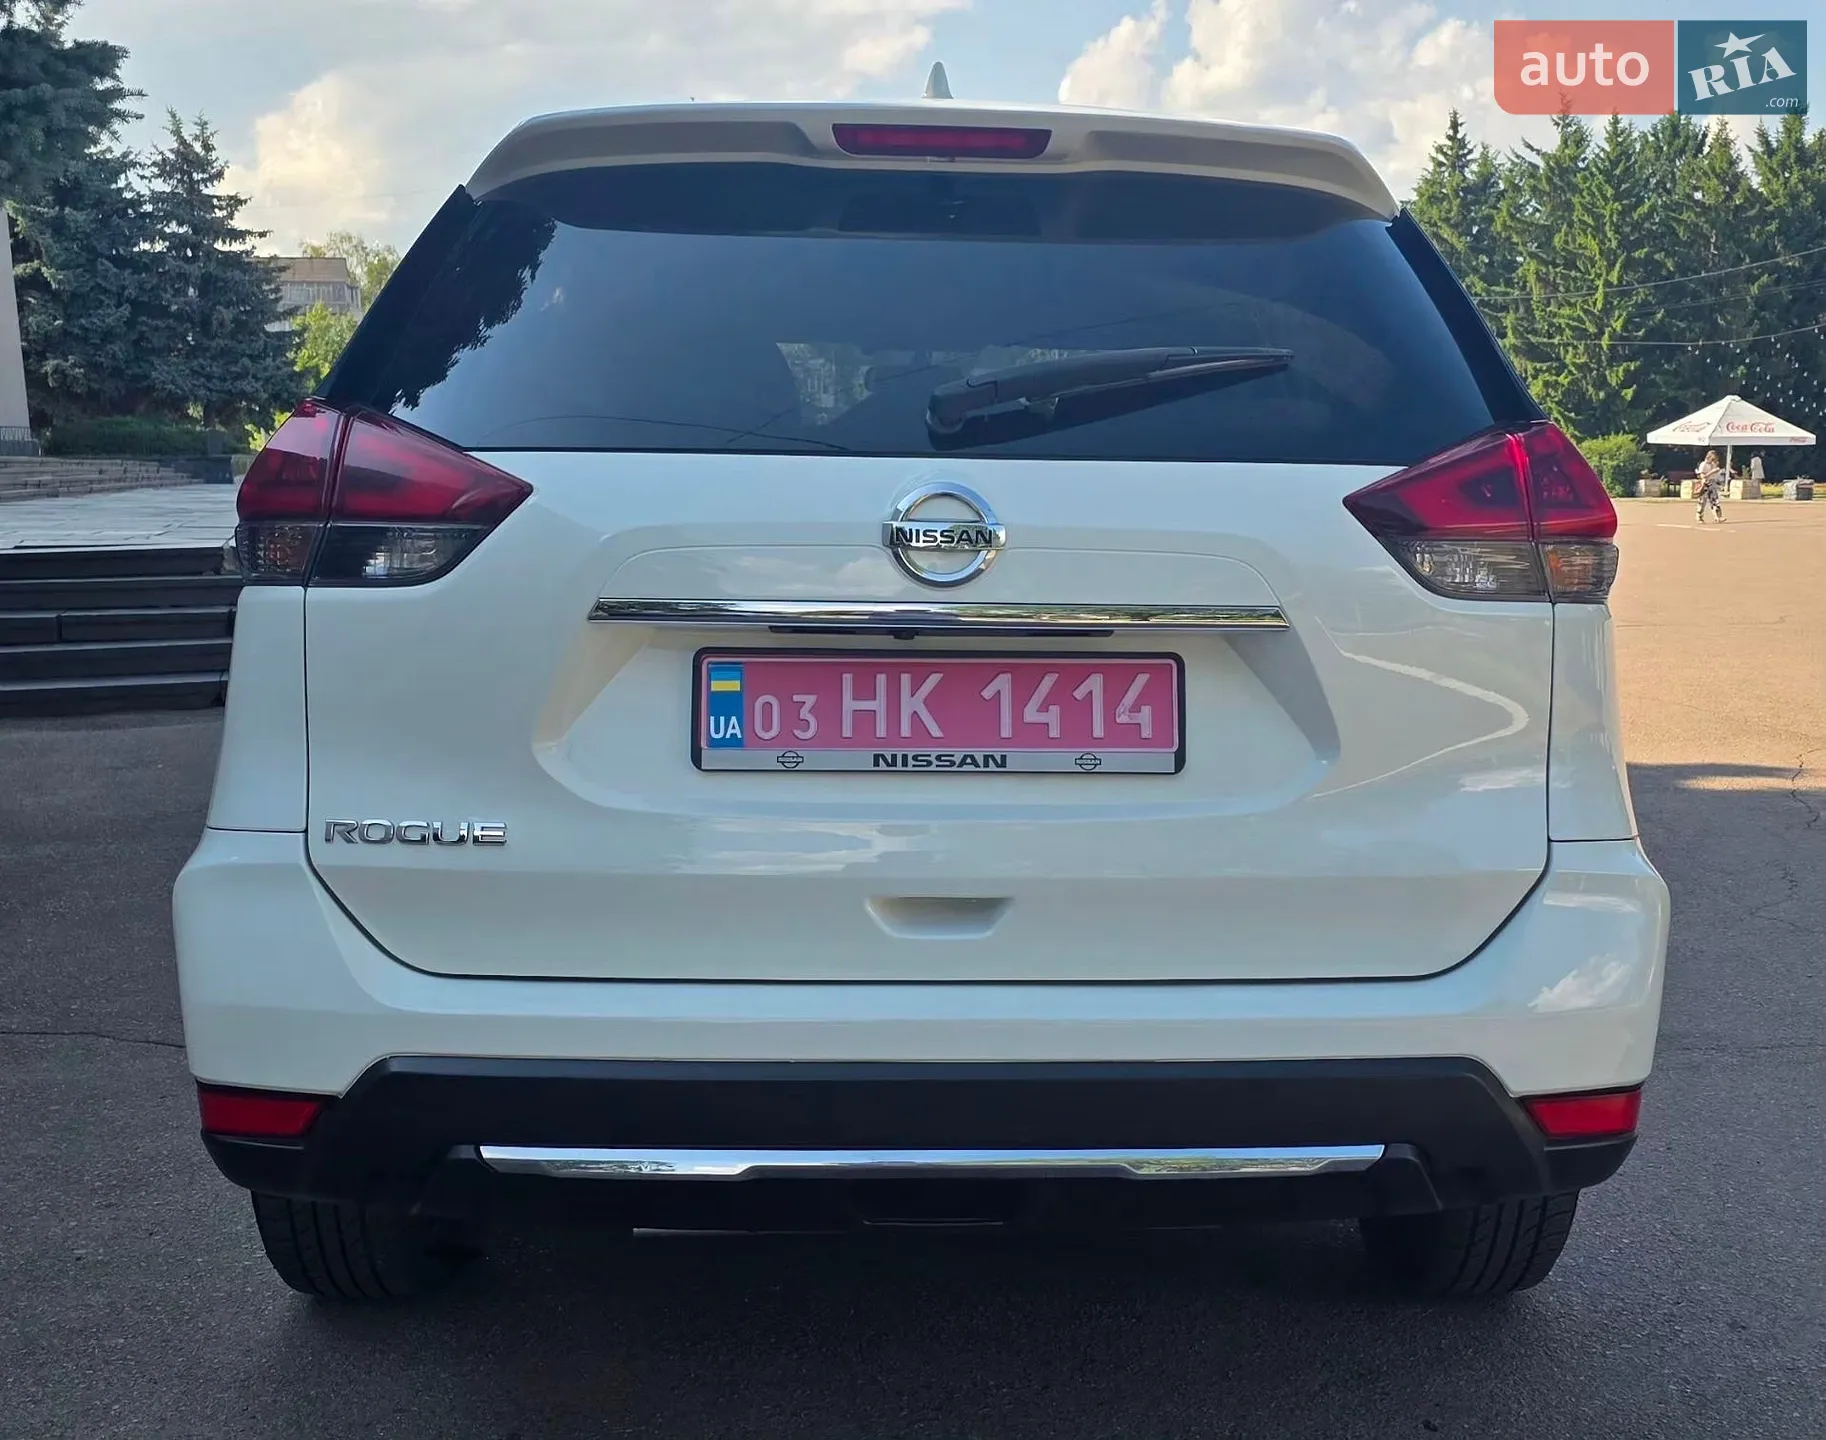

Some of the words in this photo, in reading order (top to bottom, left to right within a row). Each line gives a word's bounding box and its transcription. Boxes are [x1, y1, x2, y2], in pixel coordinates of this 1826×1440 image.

[895, 526, 993, 545] NISSAN
[753, 694, 819, 740] 03
[841, 672, 944, 740] HK
[980, 672, 1153, 740] 1414
[709, 715, 742, 739] UA
[872, 752, 1008, 768] NISSAN
[324, 818, 508, 846] ROGUE
